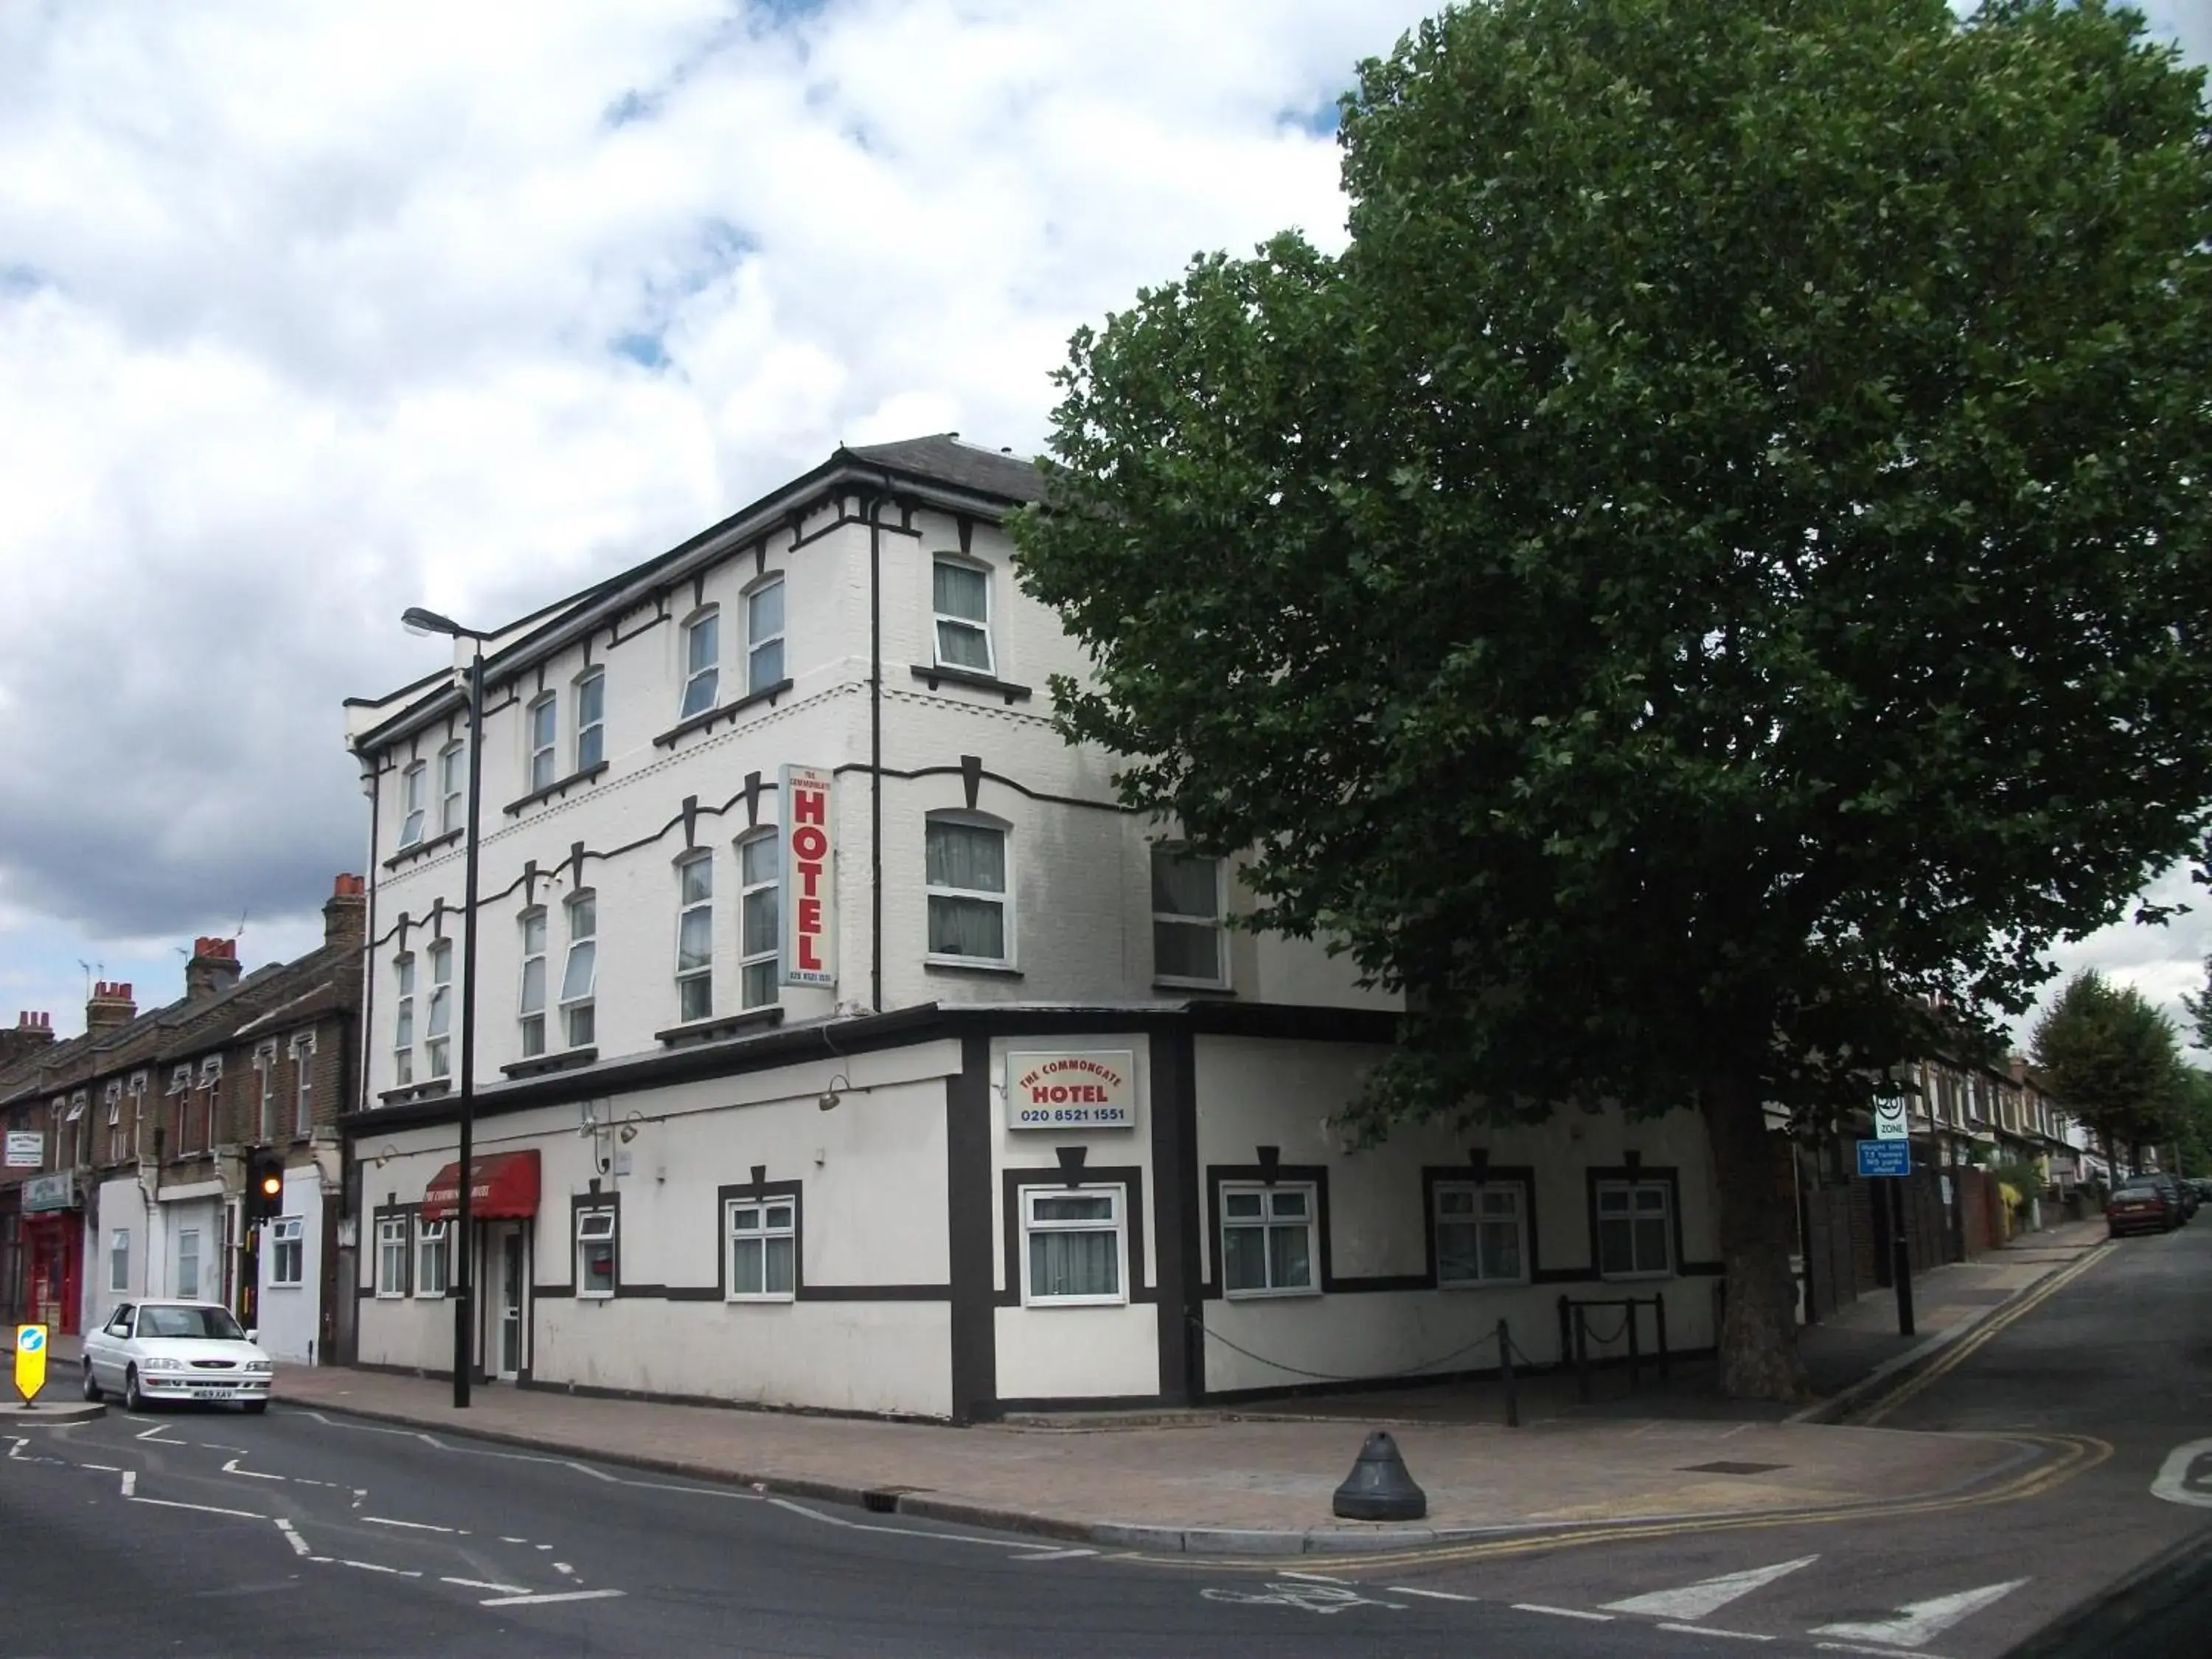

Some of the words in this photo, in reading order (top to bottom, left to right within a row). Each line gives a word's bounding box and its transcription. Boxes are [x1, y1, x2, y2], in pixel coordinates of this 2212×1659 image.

[793, 790, 827, 970] HOTEL
[1020, 1071, 1040, 1088] THE
[1042, 1060, 1121, 1087] COMMONGATE
[1032, 1085, 1108, 1104] HOTEL
[1021, 1110, 1049, 1121] 020
[1055, 1109, 1089, 1121] 8521
[1094, 1108, 1124, 1120] 1551
[1882, 1124, 1905, 1133] ZONE
